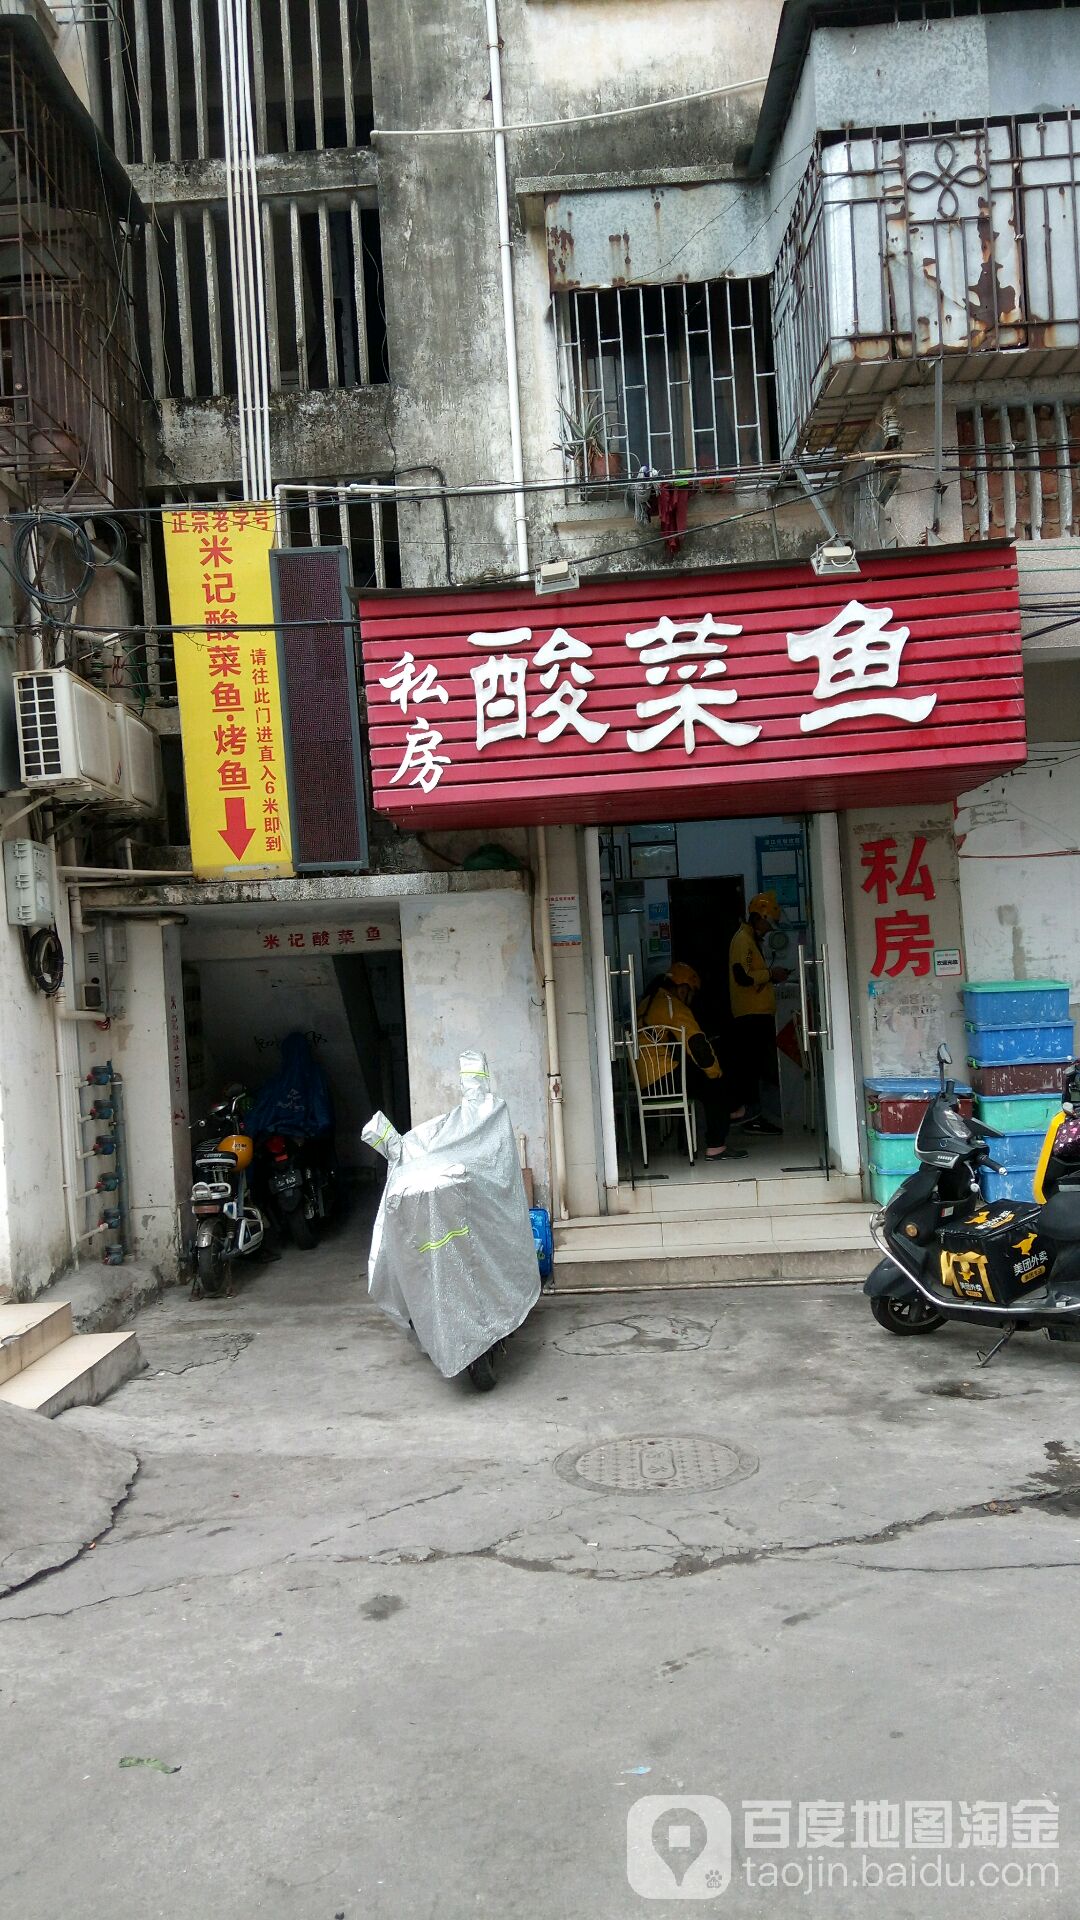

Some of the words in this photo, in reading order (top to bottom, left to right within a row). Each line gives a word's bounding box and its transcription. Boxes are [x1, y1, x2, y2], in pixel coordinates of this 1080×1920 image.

[171, 508, 270, 534] 正宗老字号
[199, 534, 251, 792] 米记酸菜鱼·烤鱼
[378, 650, 453, 794] 私房
[467, 599, 938, 756] 酸菜鱼
[250, 647, 282, 853] 请往此门进直入6米即到
[263, 926, 381, 950] 米记酸菜鱼
[860, 834, 936, 977] 私房
[1013, 1250, 1048, 1277] 美团外卖
